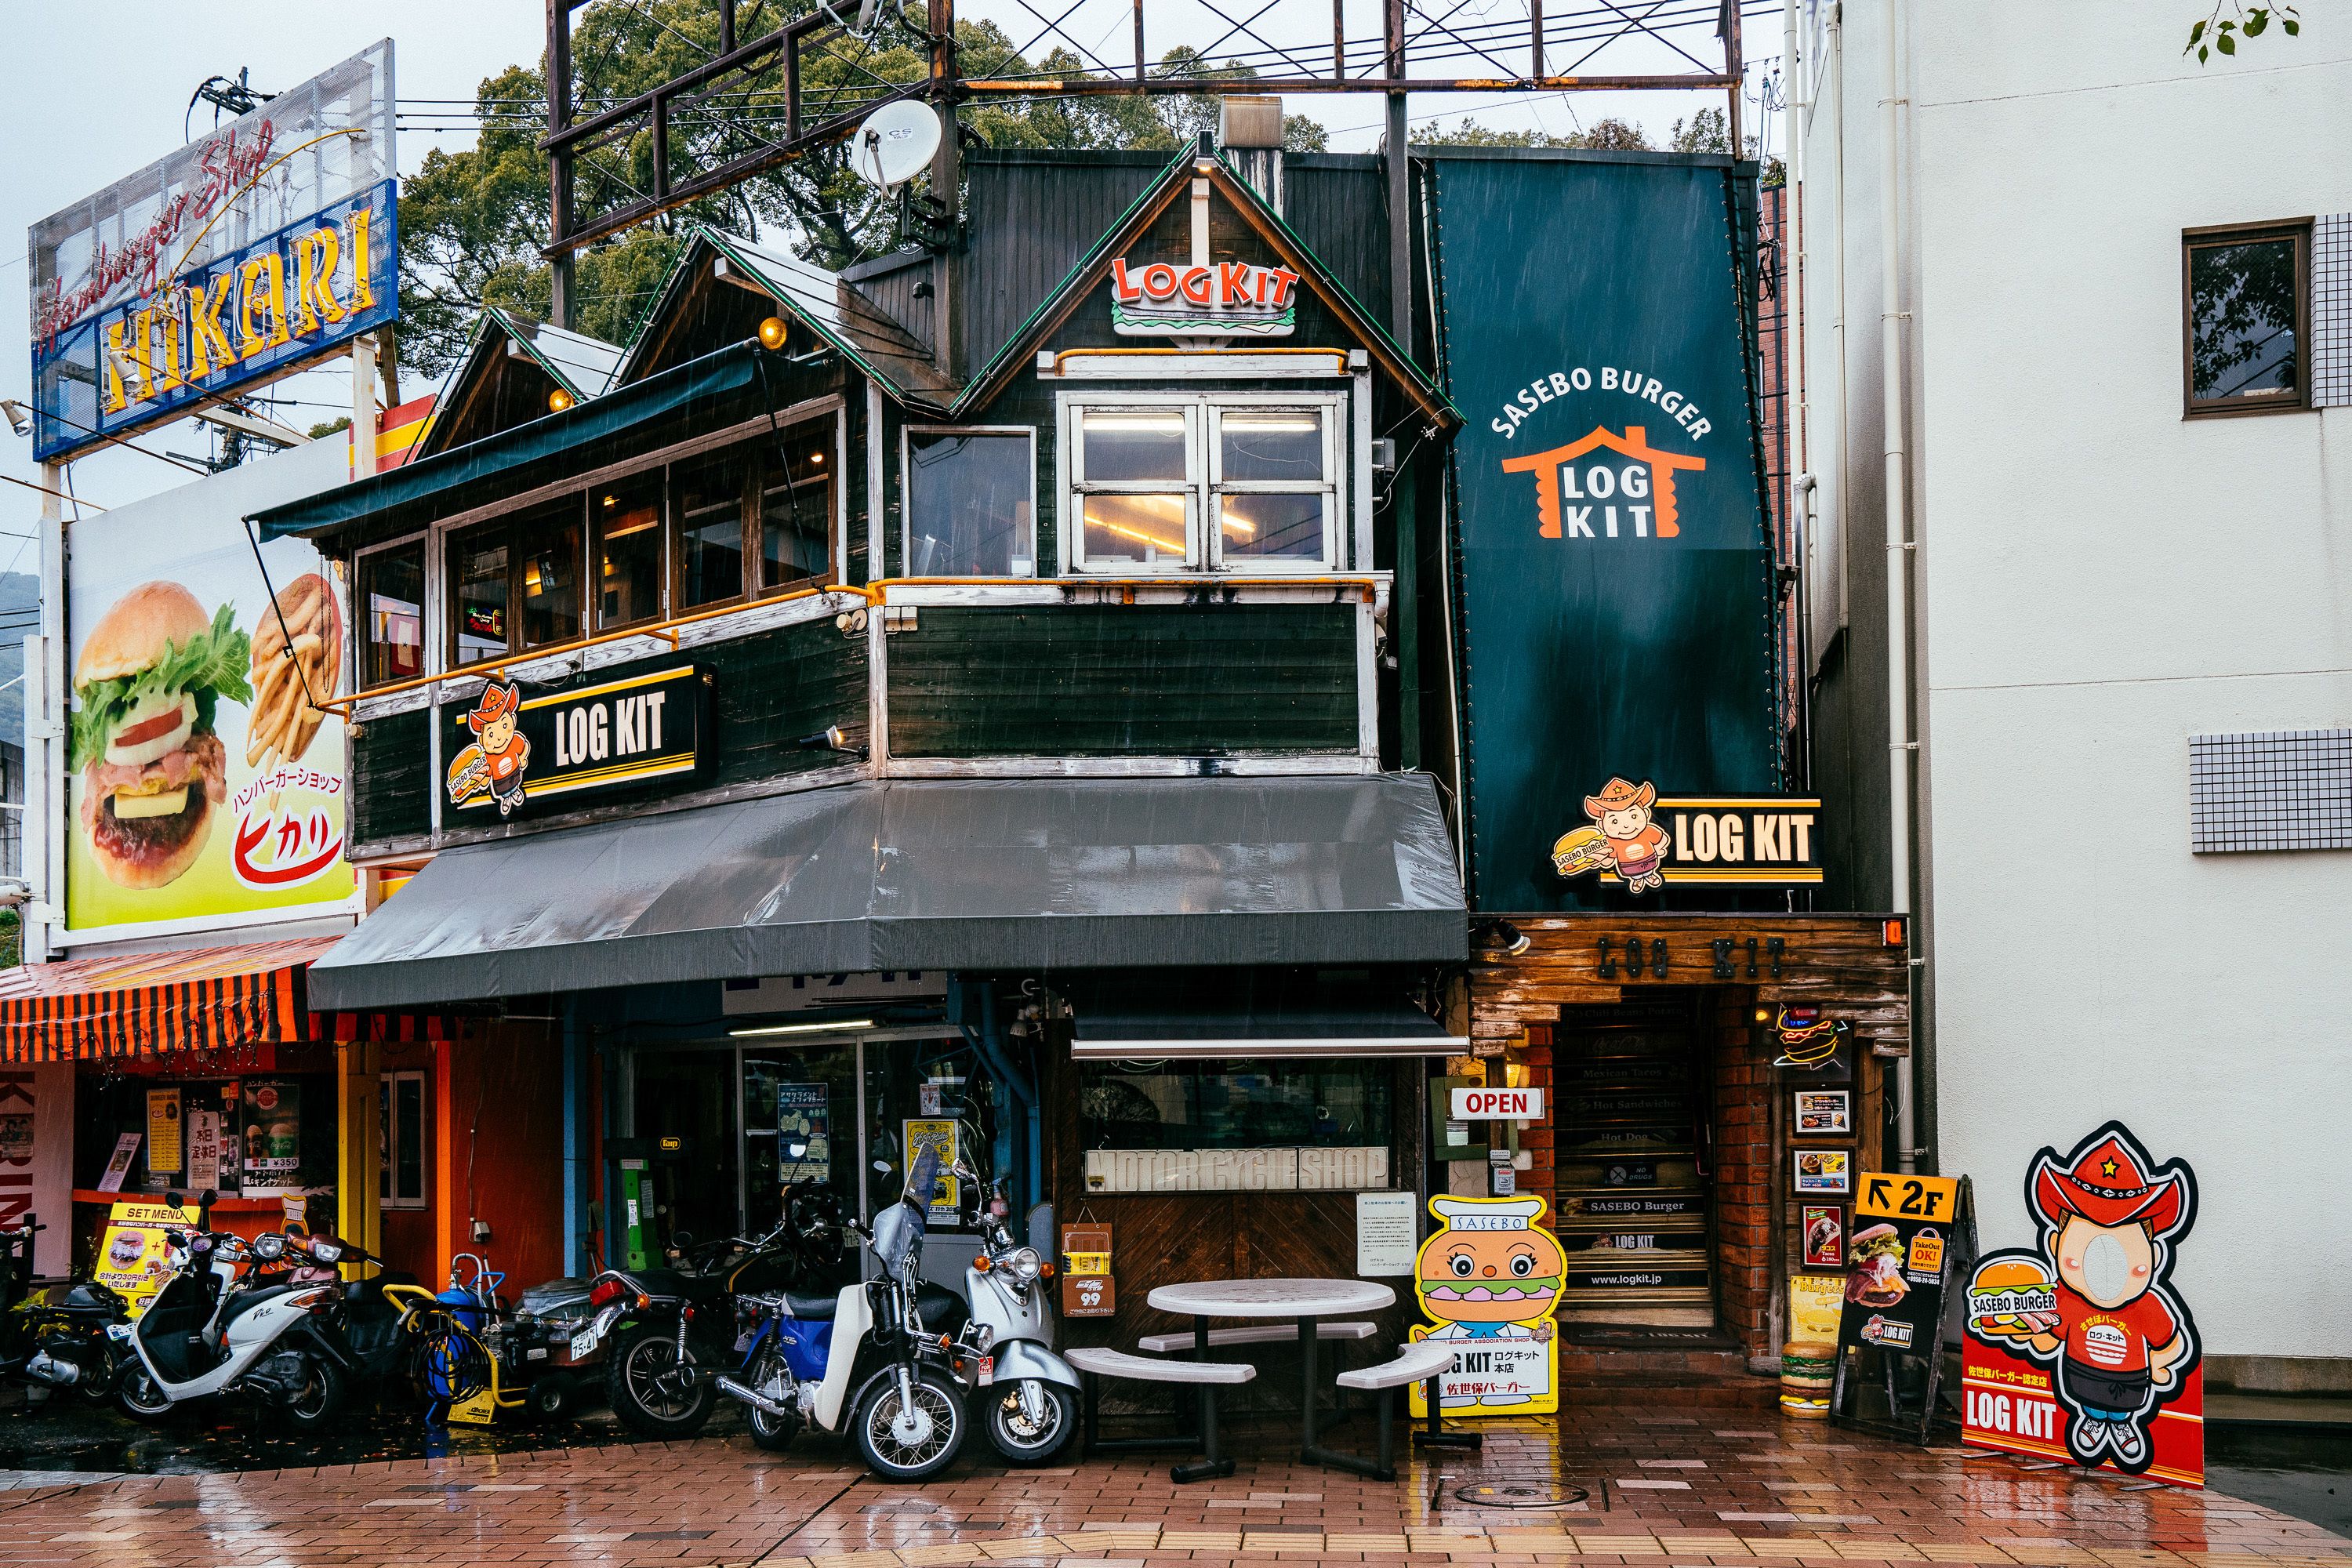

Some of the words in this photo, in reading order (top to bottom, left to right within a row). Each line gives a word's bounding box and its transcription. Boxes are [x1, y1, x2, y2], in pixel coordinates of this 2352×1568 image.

[194, 117, 274, 220] Shop
[1490, 366, 1593, 441] SASEBO
[1601, 366, 1713, 441] BURGER
[1563, 465, 1649, 499] LOG
[1567, 504, 1651, 539] KIT
[555, 702, 608, 768] LOG
[615, 691, 666, 756] KIT
[450, 773, 468, 793] SASEBO
[467, 756, 487, 778] BURGER
[234, 768, 343, 814] ハンバーガーショップ
[234, 811, 343, 884] ヒカリ
[1675, 814, 1745, 862] LOG
[1754, 814, 1814, 862] KIT
[1556, 850, 1582, 867] SASEBO
[1581, 838, 1609, 855] BURGER
[1596, 937, 1669, 979] LOG
[1712, 937, 1787, 979] KIT
[1582, 1068, 1628, 1079] Mexican
[1632, 1067, 1663, 1078] Tacos
[1465, 1092, 1528, 1114] OPEN
[1592, 1100, 1615, 1110] Hot
[1617, 1098, 1683, 1109] Sandwiches
[1601, 1133, 1623, 1142] Hot
[273, 1158, 298, 1167] ¥350
[1299, 1148, 1388, 1189] SHOP
[1590, 1202, 1642, 1212] SASEBO
[1644, 1200, 1685, 1213] Burger
[1899, 1180, 1944, 1217] 2F
[126, 1207, 151, 1218] SET
[151, 1209, 184, 1220] MENU
[1456, 1215, 1523, 1229] SASEBO
[1615, 1235, 1635, 1249] LOG
[1637, 1235, 1655, 1248] KIT
[1914, 1241, 1940, 1250] TakeOut
[1915, 1250, 1936, 1261] OK!
[1591, 1273, 1662, 1286] www.logkit.jp
[1799, 1282, 1845, 1295] Burgers
[1973, 1297, 2011, 1313] SASEBO
[2014, 1294, 2056, 1311] BURGER
[1884, 1325, 1898, 1339] LOG
[1897, 1327, 1911, 1341] KIT
[2079, 1314, 2132, 1337] させぼバーガー
[2089, 1330, 2125, 1341] ログ・キット
[573, 1335, 595, 1359] 75-41
[1494, 1350, 1540, 1361] ログキット
[1465, 1352, 1492, 1374] KIT
[1494, 1363, 1515, 1374] 本店
[1968, 1365, 2048, 1388] 佐世保バーガー認定店
[1446, 1381, 1530, 1396] 佐世保バーガー
[1966, 1391, 2011, 1432] LOG
[2016, 1398, 2057, 1440] KIT
